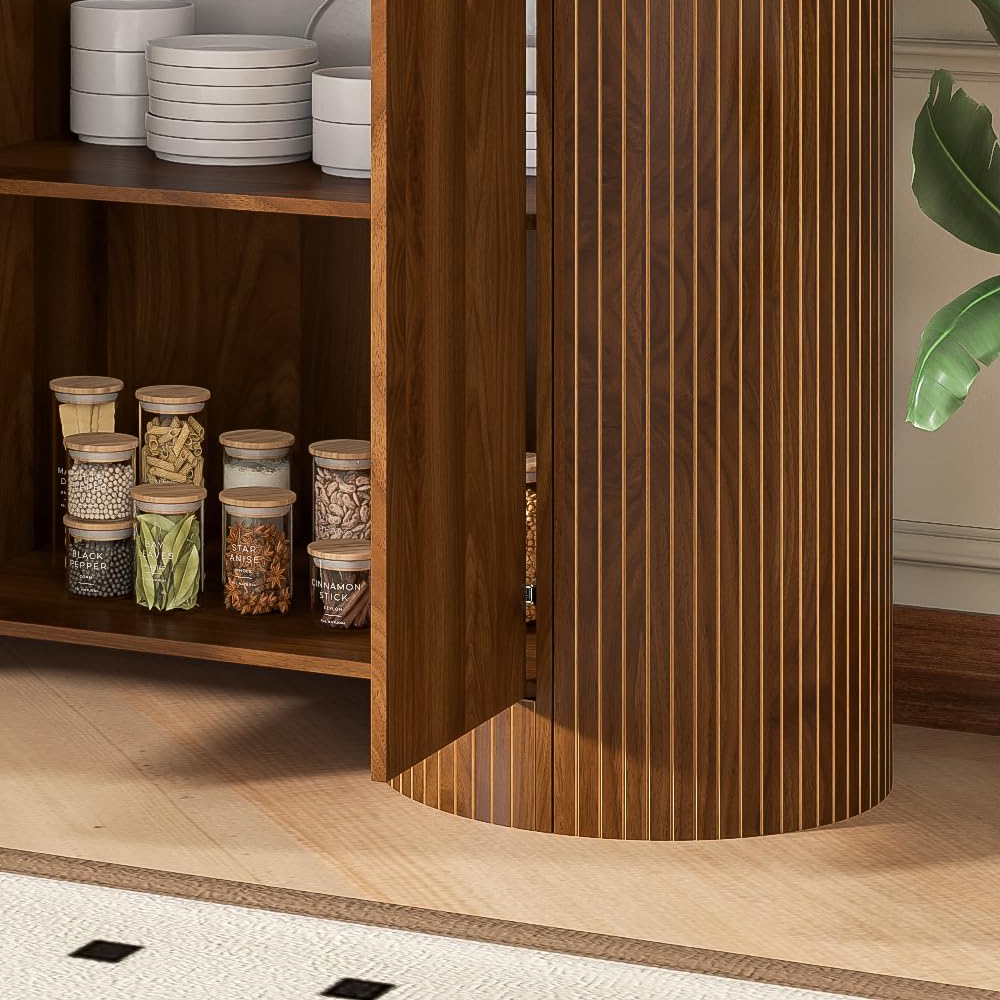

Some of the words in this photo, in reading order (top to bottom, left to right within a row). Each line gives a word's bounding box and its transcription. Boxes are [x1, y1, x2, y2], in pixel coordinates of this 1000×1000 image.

[231, 543, 257, 553] STAR
[72, 549, 104, 560] BLACK
[229, 553, 260, 564] ANISE
[69, 559, 107, 570] PEPPER
[311, 578, 361, 591] CINNAMON
[319, 591, 349, 602] STICK
